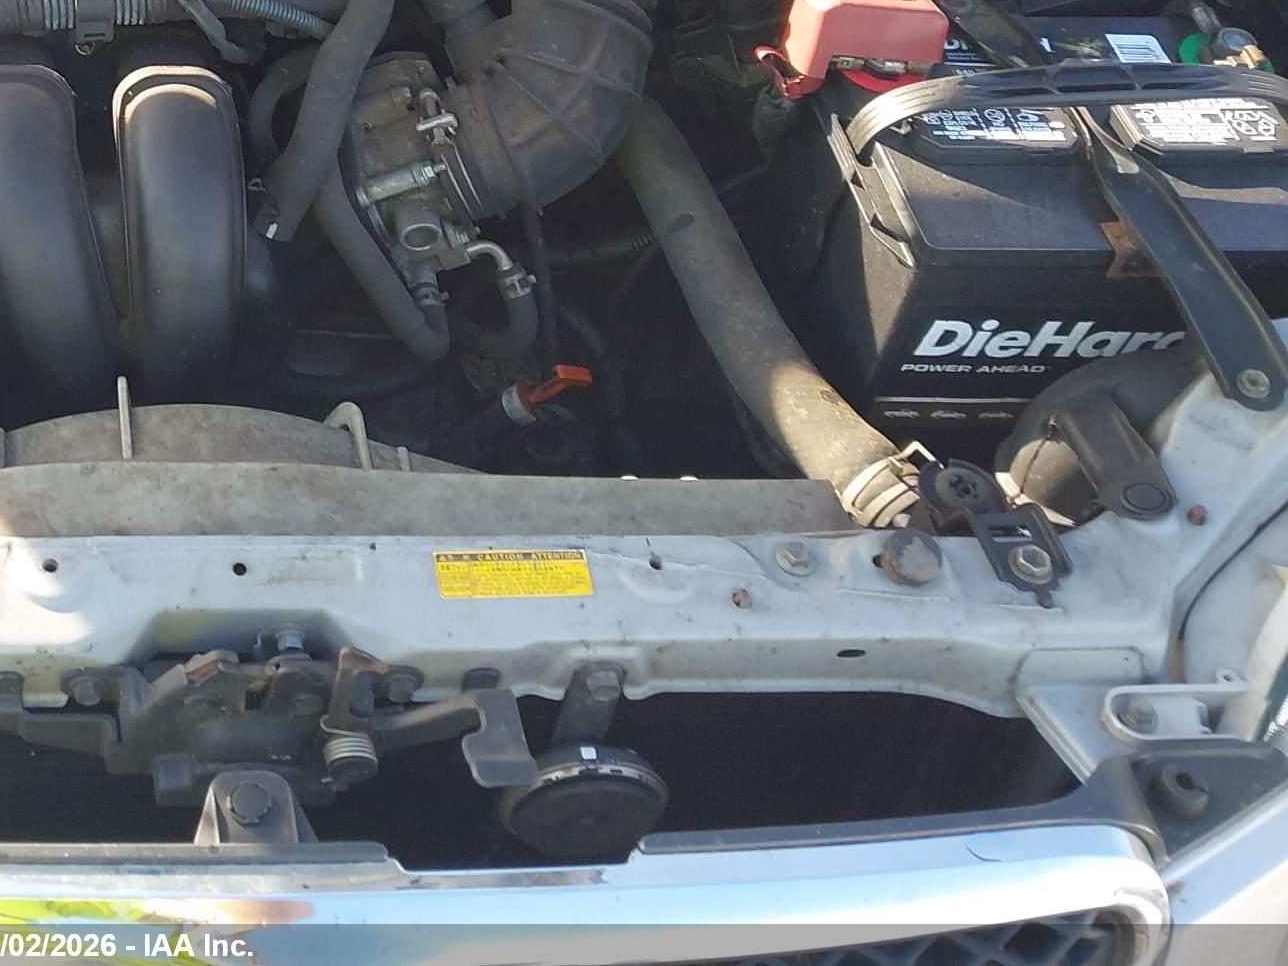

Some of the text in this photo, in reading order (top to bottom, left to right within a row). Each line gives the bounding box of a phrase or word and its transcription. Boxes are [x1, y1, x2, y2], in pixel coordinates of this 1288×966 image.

[900, 364, 1046, 373] POWER AHEAD
[476, 553, 524, 562] CAUTION
[530, 551, 584, 561] ATTENTION
